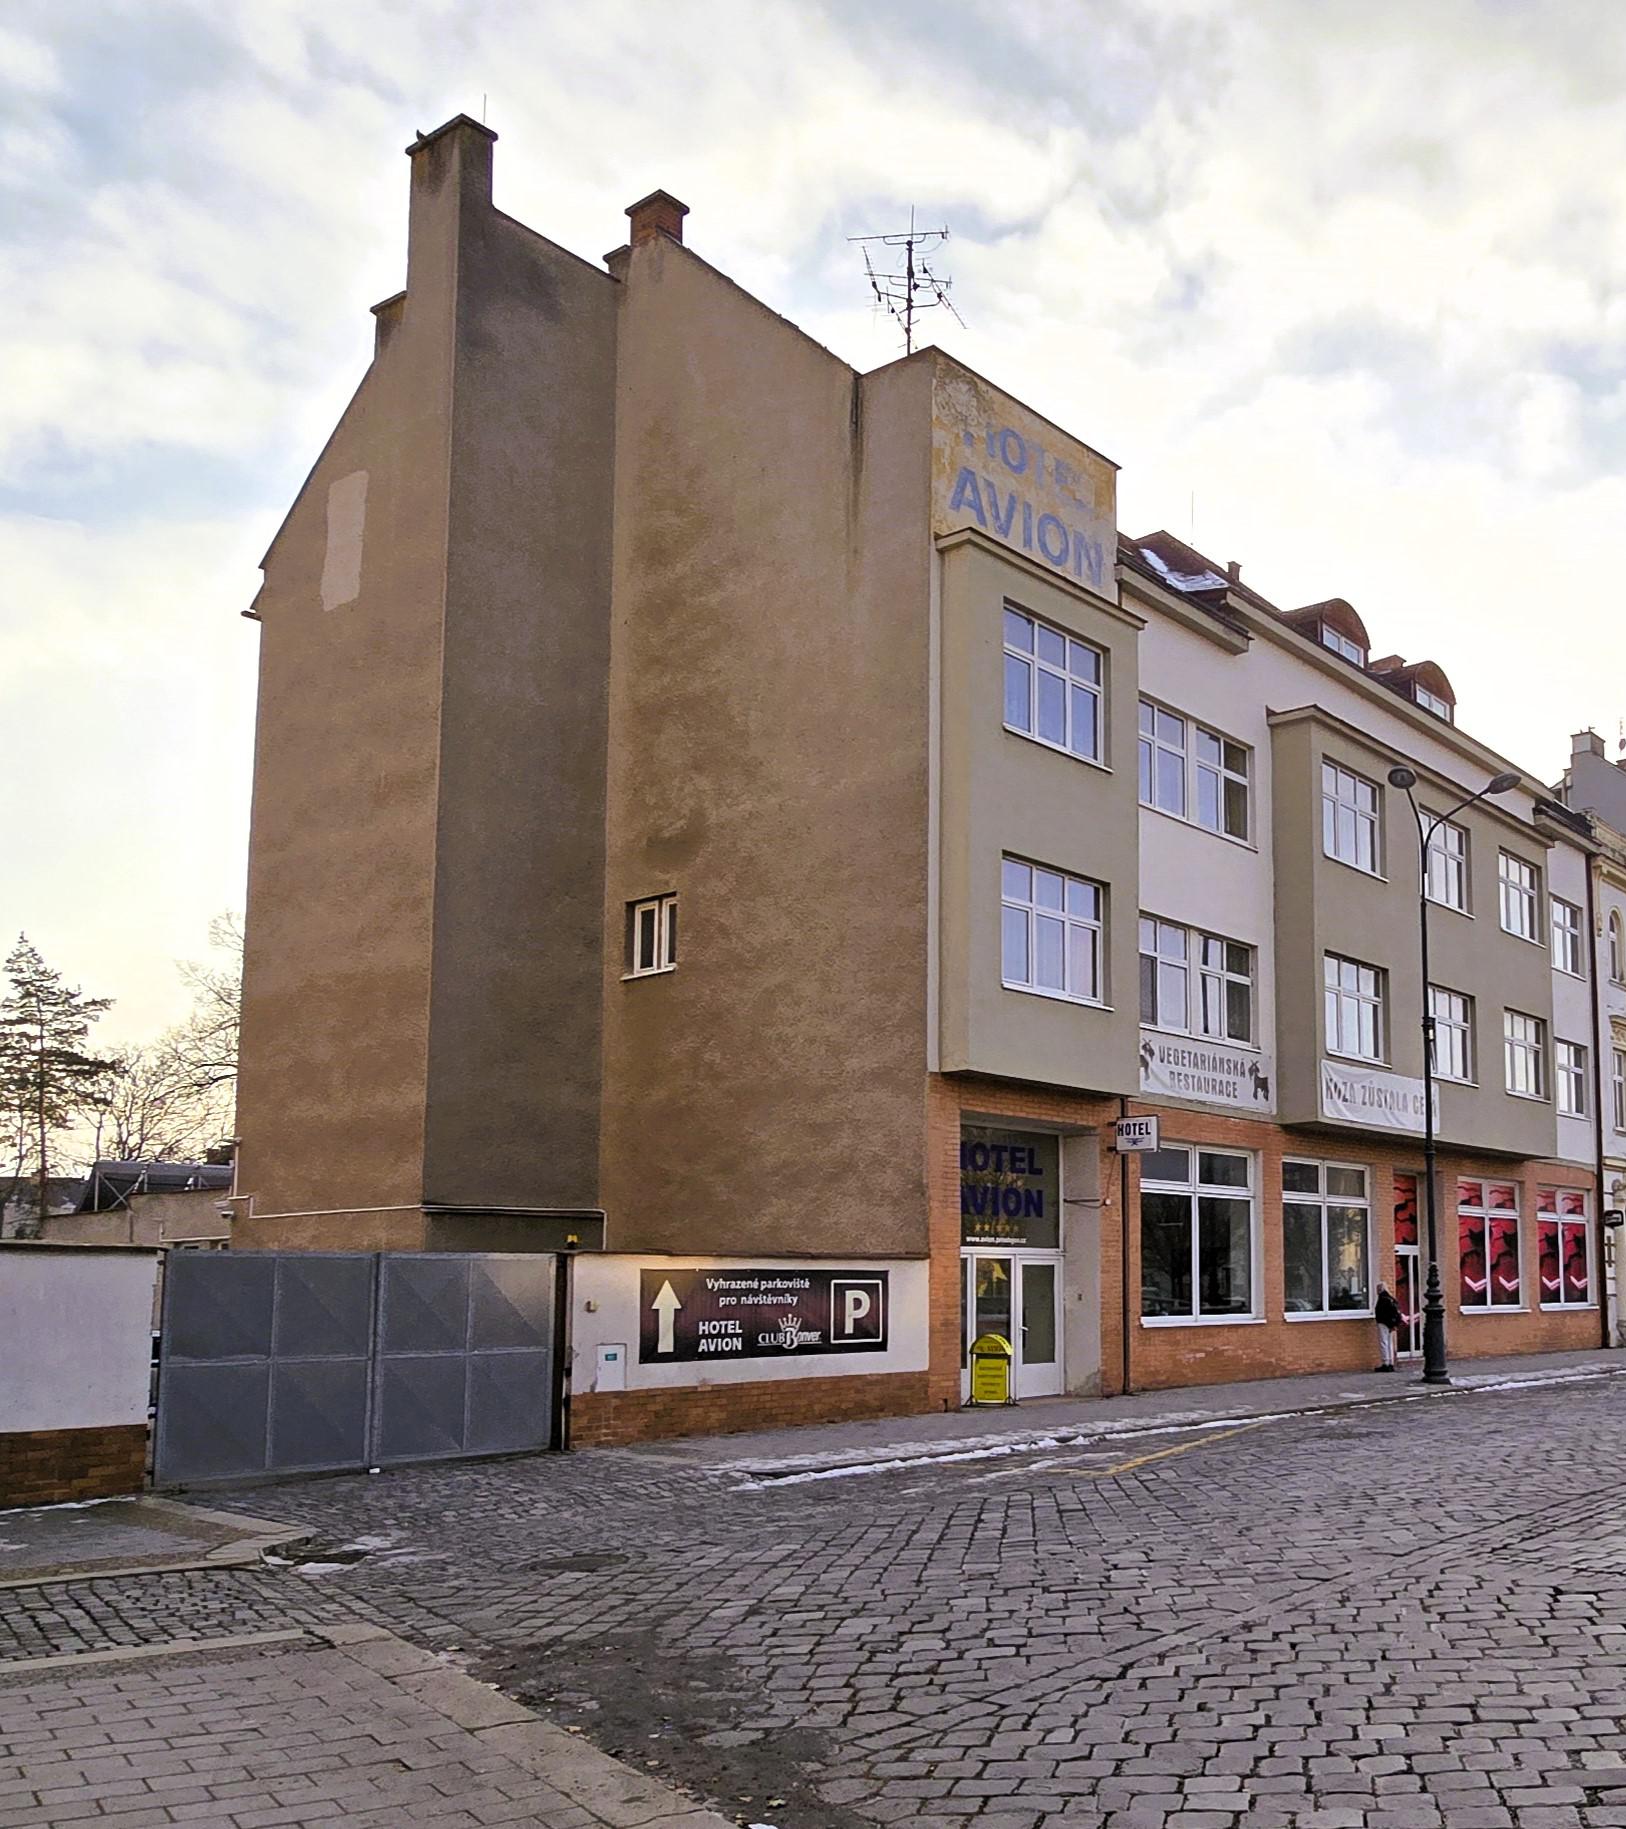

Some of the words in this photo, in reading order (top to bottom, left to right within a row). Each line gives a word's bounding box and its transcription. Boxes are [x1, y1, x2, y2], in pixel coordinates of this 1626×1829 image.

[949, 466, 1103, 588] AVION
[1159, 1045, 1246, 1079] VEGETARIÁNSKÁ
[1169, 1070, 1238, 1099] RESTAURACE
[1117, 1122, 1151, 1137] HOTEL
[706, 1278, 759, 1292] Vyhrazené
[760, 1278, 810, 1291] parkoviště
[719, 1297, 737, 1307] pro
[741, 1293, 798, 1307] návštěvníky
[845, 1290, 870, 1334] P
[698, 1320, 743, 1335] HOTEL
[698, 1338, 742, 1353] AVION
[758, 1333, 785, 1344] CLUB
